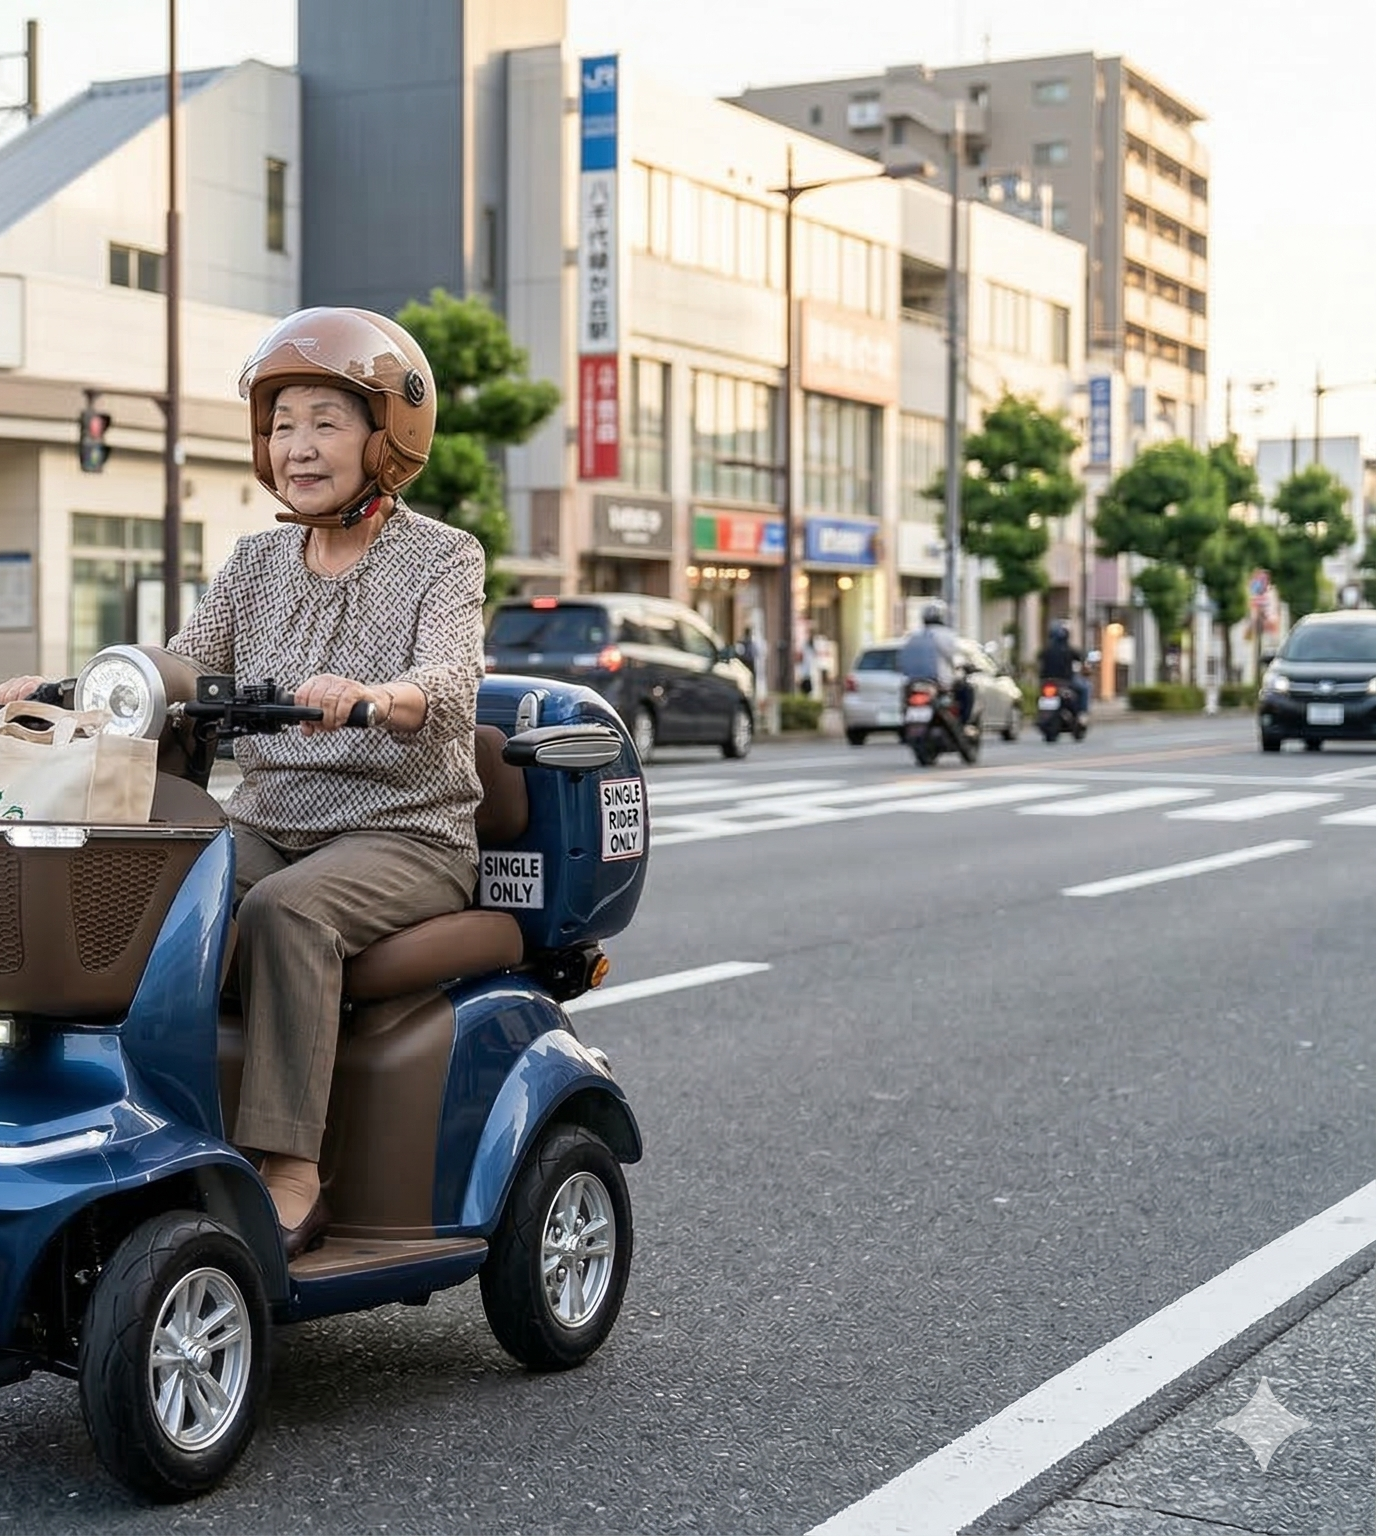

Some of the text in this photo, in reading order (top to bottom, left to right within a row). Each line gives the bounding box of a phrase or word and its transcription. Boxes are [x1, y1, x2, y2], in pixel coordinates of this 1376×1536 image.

[603, 784, 641, 806] SINGLE
[609, 808, 639, 830] RIDER
[610, 832, 638, 853] ONLY
[484, 856, 539, 878] SINGLE
[490, 882, 533, 904] ONLY
